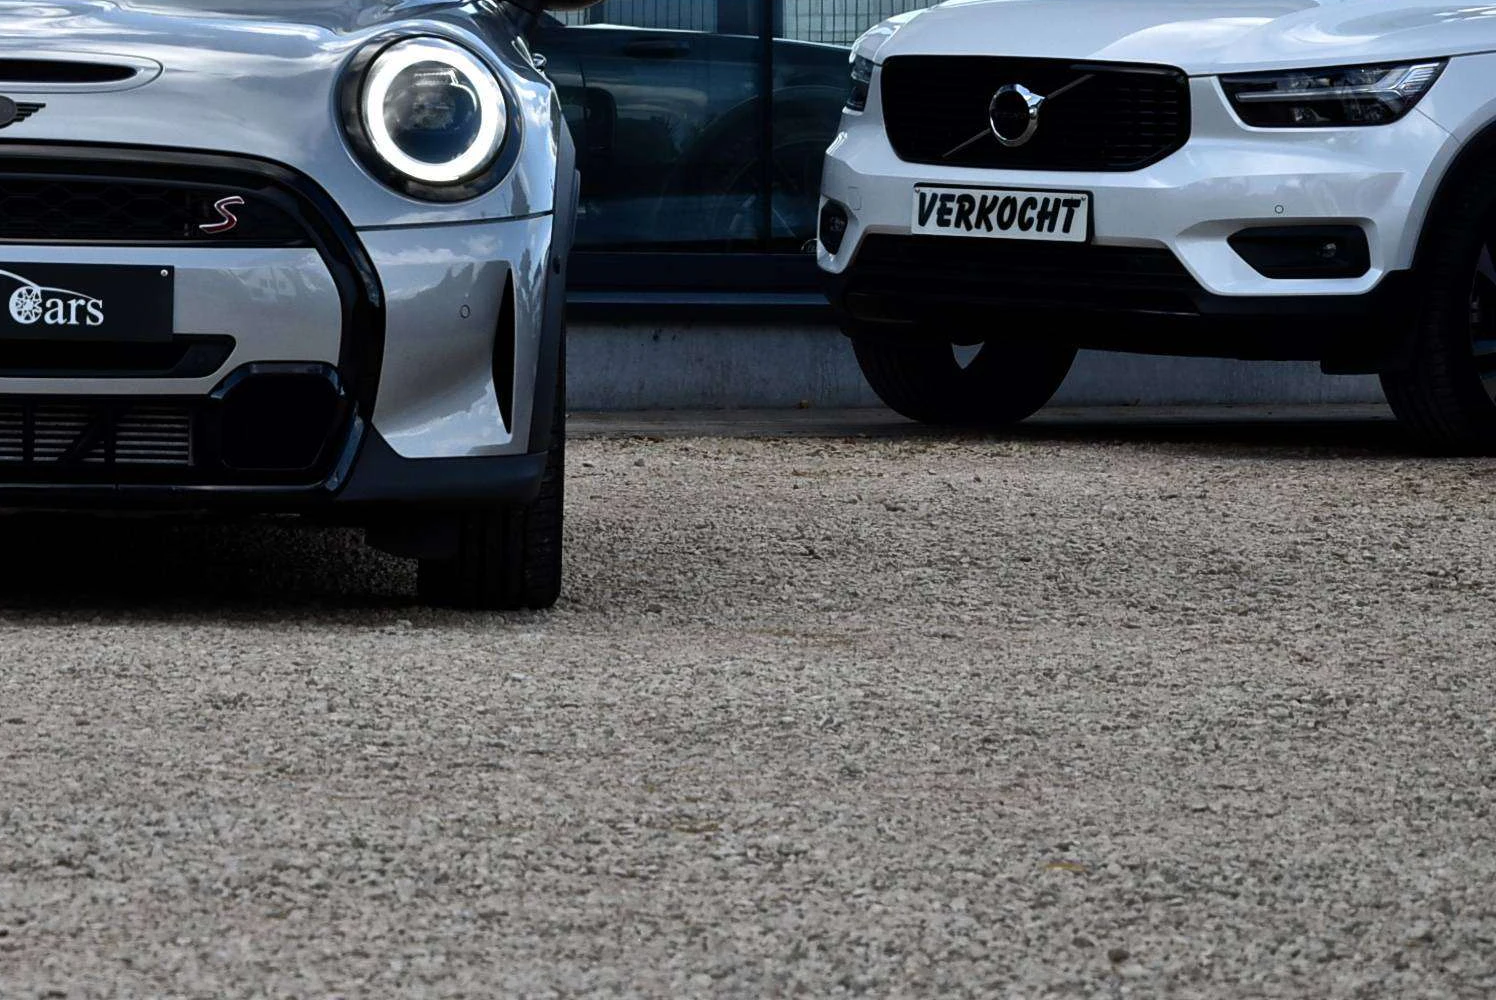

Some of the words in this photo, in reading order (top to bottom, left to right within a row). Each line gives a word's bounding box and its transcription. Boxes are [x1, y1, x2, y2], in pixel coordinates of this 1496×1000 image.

[199, 195, 244, 234] S
[917, 192, 1081, 233] VERKOCHT
[9, 286, 104, 326] Cars
